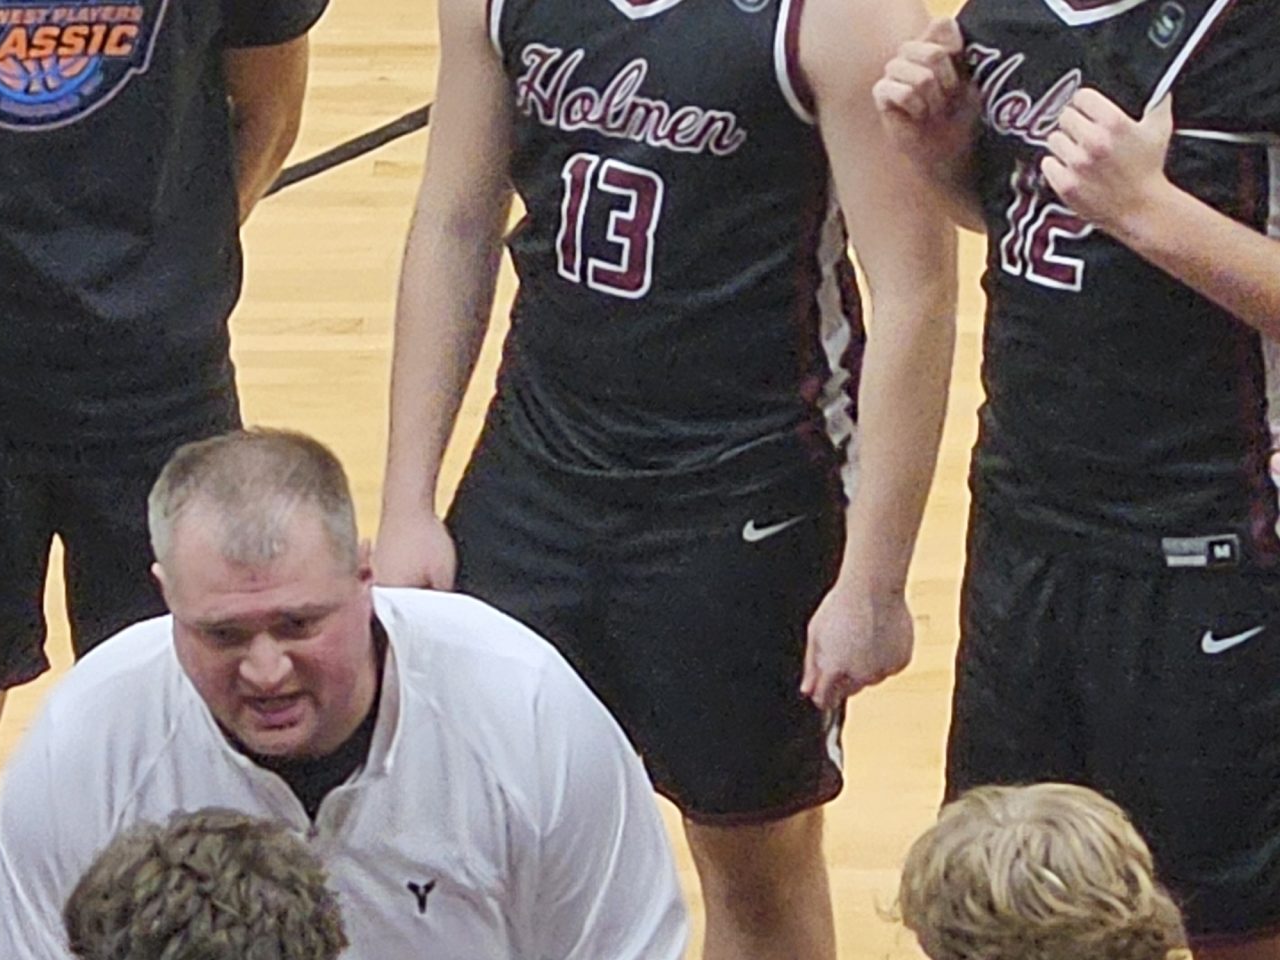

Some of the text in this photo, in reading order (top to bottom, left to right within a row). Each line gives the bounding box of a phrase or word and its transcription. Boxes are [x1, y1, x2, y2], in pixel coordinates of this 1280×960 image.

[52, 6, 143, 22] PLAYERS
[517, 43, 747, 155] Holmen
[556, 153, 664, 299] 13
[1001, 160, 1088, 291] 12
